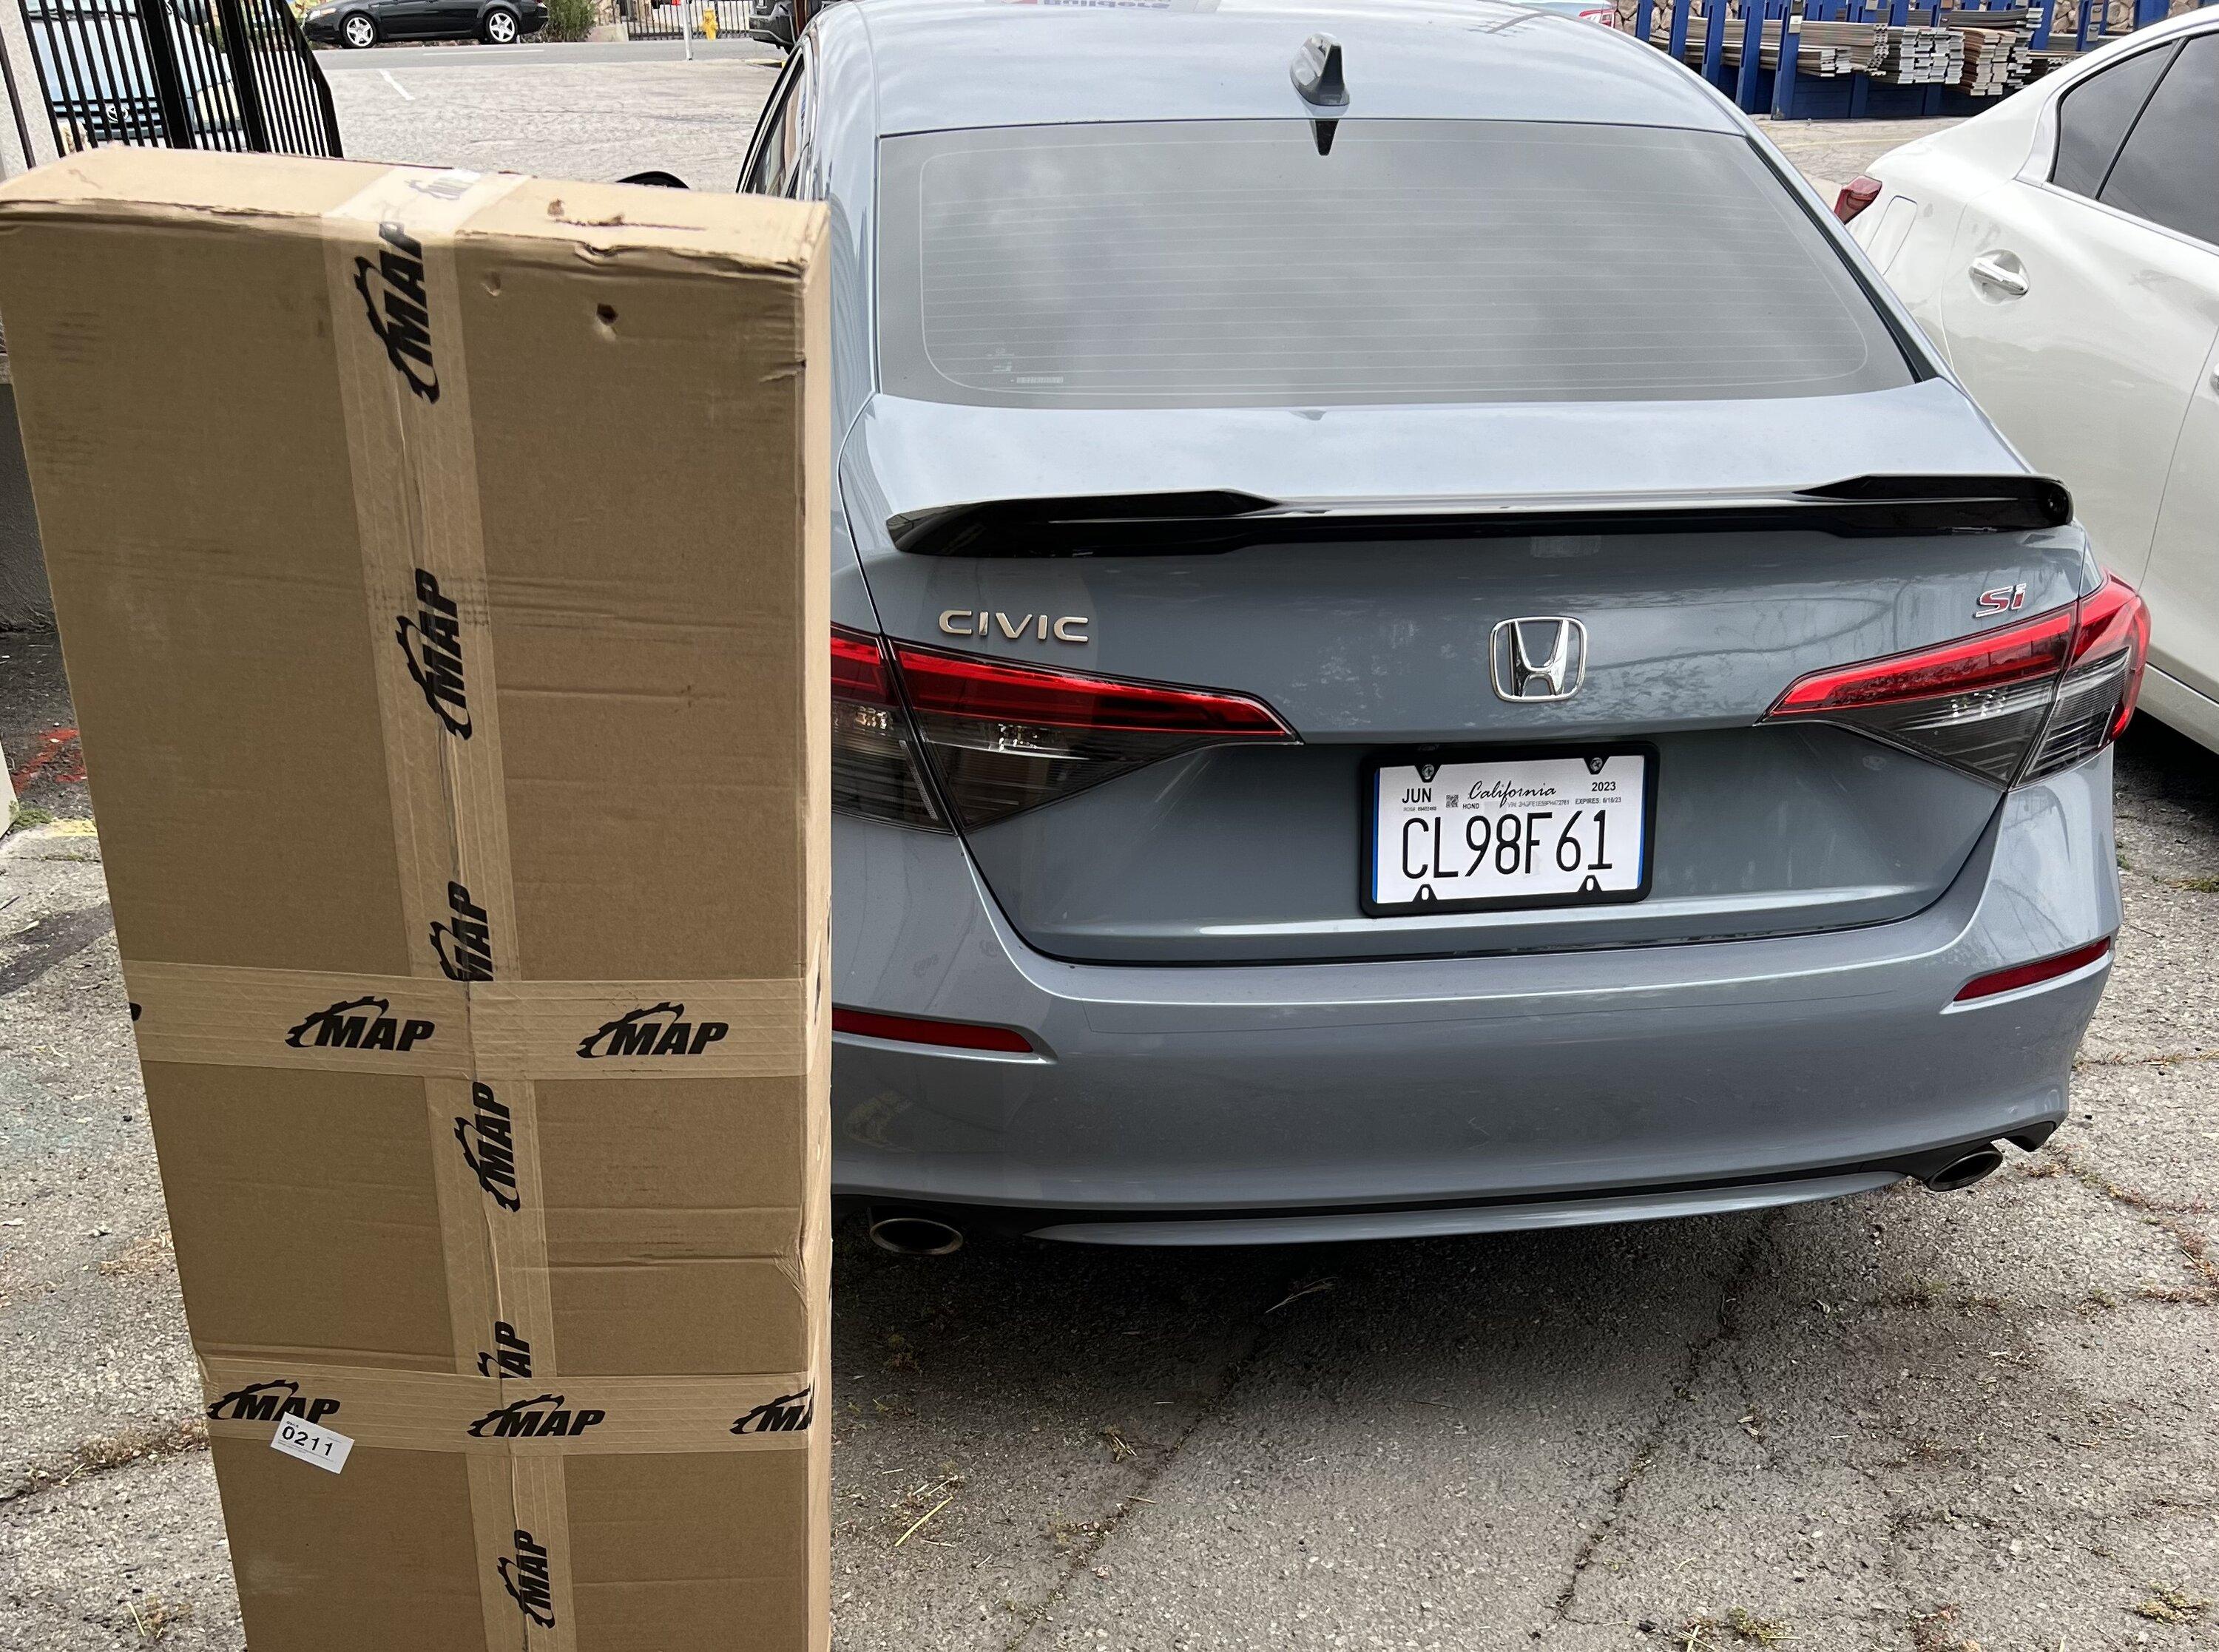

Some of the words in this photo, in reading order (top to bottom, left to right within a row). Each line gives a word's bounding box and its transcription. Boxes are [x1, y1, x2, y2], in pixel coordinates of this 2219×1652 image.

[1974, 583, 2027, 618] Si
[939, 610, 1089, 643] CIVIC
[1402, 788, 1432, 804] JUN
[1469, 780, 1557, 808] California
[1592, 781, 1617, 792] 2023
[1402, 810, 1612, 879] CL98F61
[494, 1321, 532, 1378] AP
[282, 1426, 334, 1457] 0211
